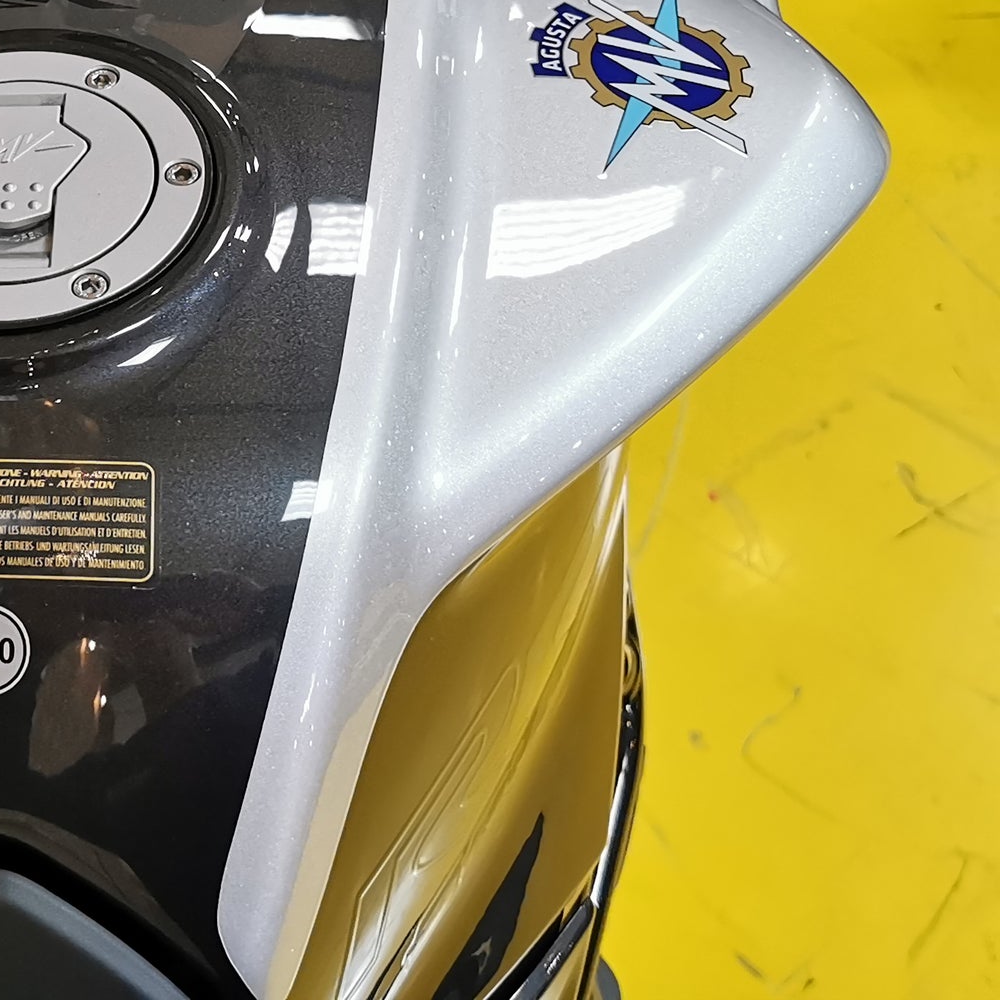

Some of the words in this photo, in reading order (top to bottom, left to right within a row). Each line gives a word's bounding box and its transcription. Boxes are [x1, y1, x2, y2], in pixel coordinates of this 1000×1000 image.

[541, 10, 583, 72] AGUSTA
[30, 469, 82, 478] WARNING
[90, 470, 149, 480] ATTENTION
[19, 496, 50, 505] MANUALI
[52, 496, 60, 505] DI
[62, 496, 75, 505] USO
[84, 497, 91, 505] DI
[93, 497, 146, 508] MANUTENZIONE
[18, 510, 32, 519] AND
[33, 511, 77, 520] MAINTENANCE
[80, 512, 110, 521] MANUALS
[8, 525, 19, 534] LES
[21, 526, 50, 535] MANUELS
[98, 528, 104, 537] ET
[36, 542, 51, 551] UND
[7, 557, 44, 566] MANUALES
